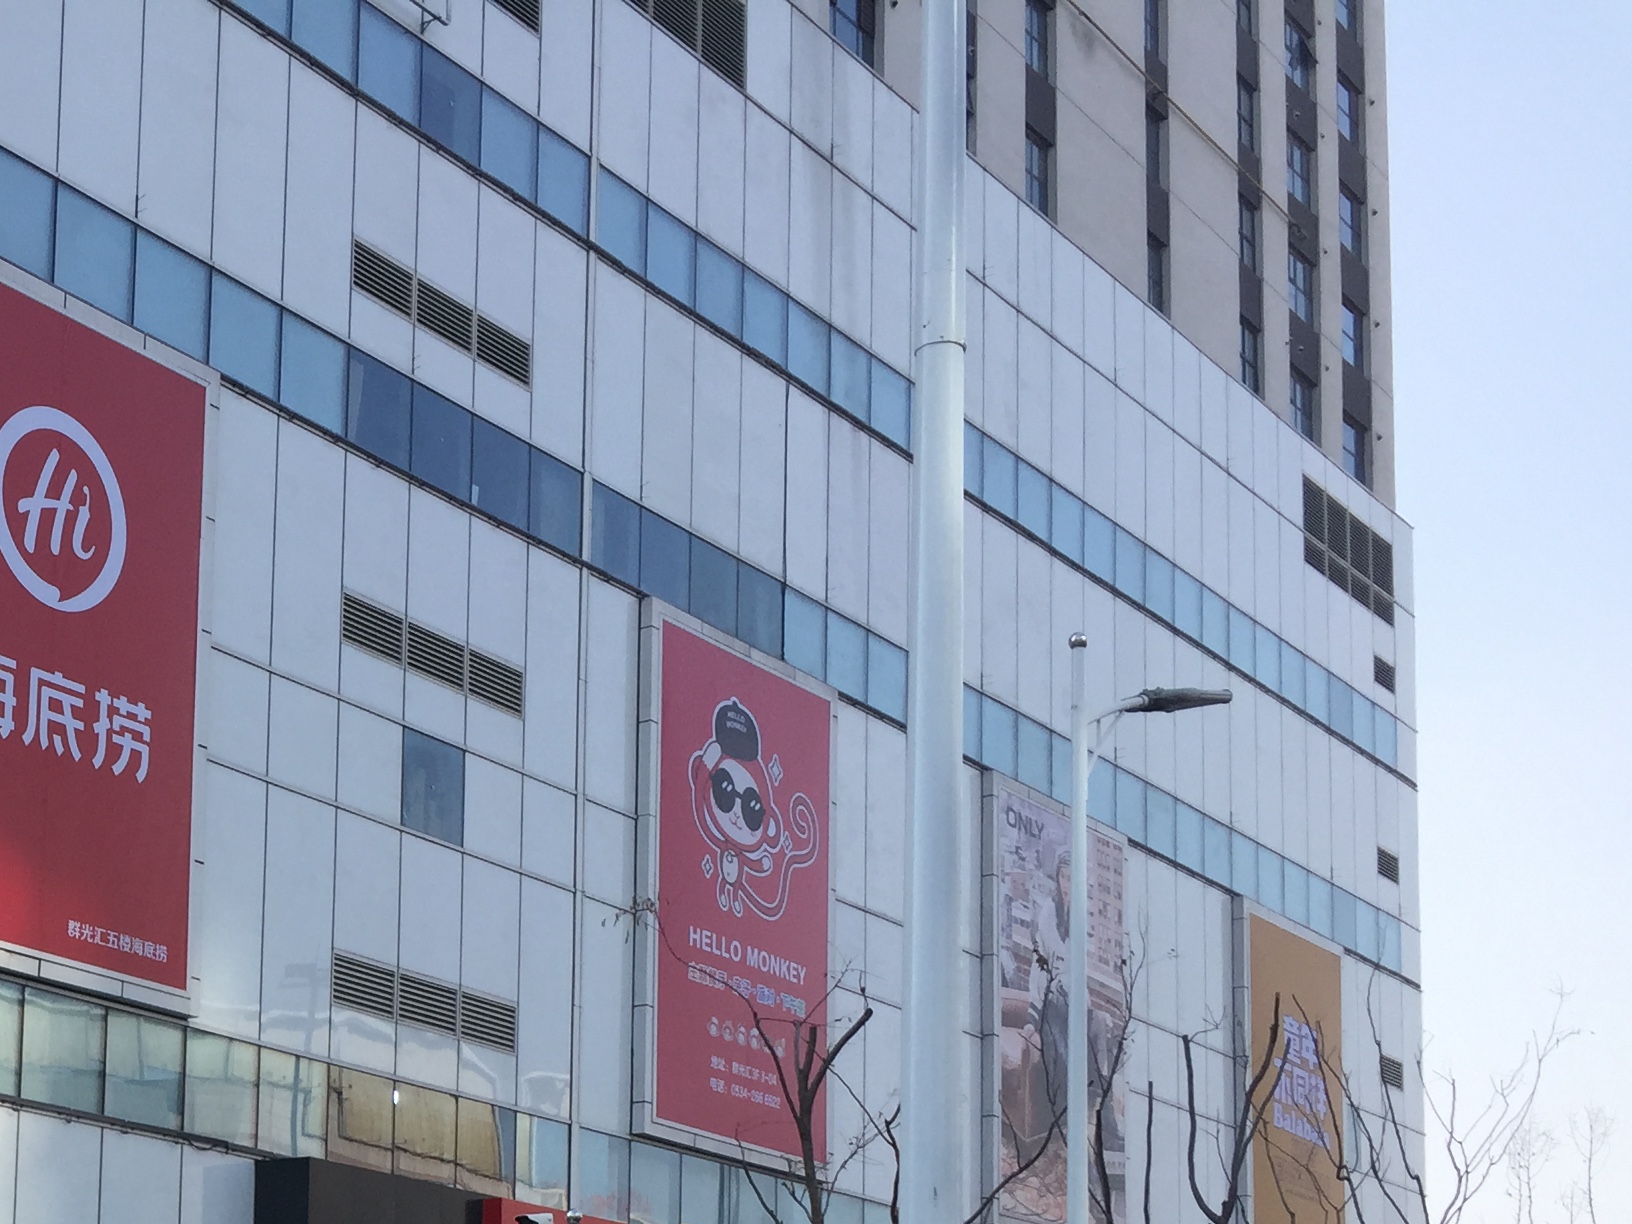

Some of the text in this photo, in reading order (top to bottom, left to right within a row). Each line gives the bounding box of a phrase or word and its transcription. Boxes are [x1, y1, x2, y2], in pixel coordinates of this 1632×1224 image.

[18, 447, 97, 562] Hi
[1006, 805, 1044, 840] ONLY
[67, 919, 168, 963] 群光汇五楼海底捞
[688, 925, 807, 985] HELLO MONKEY
